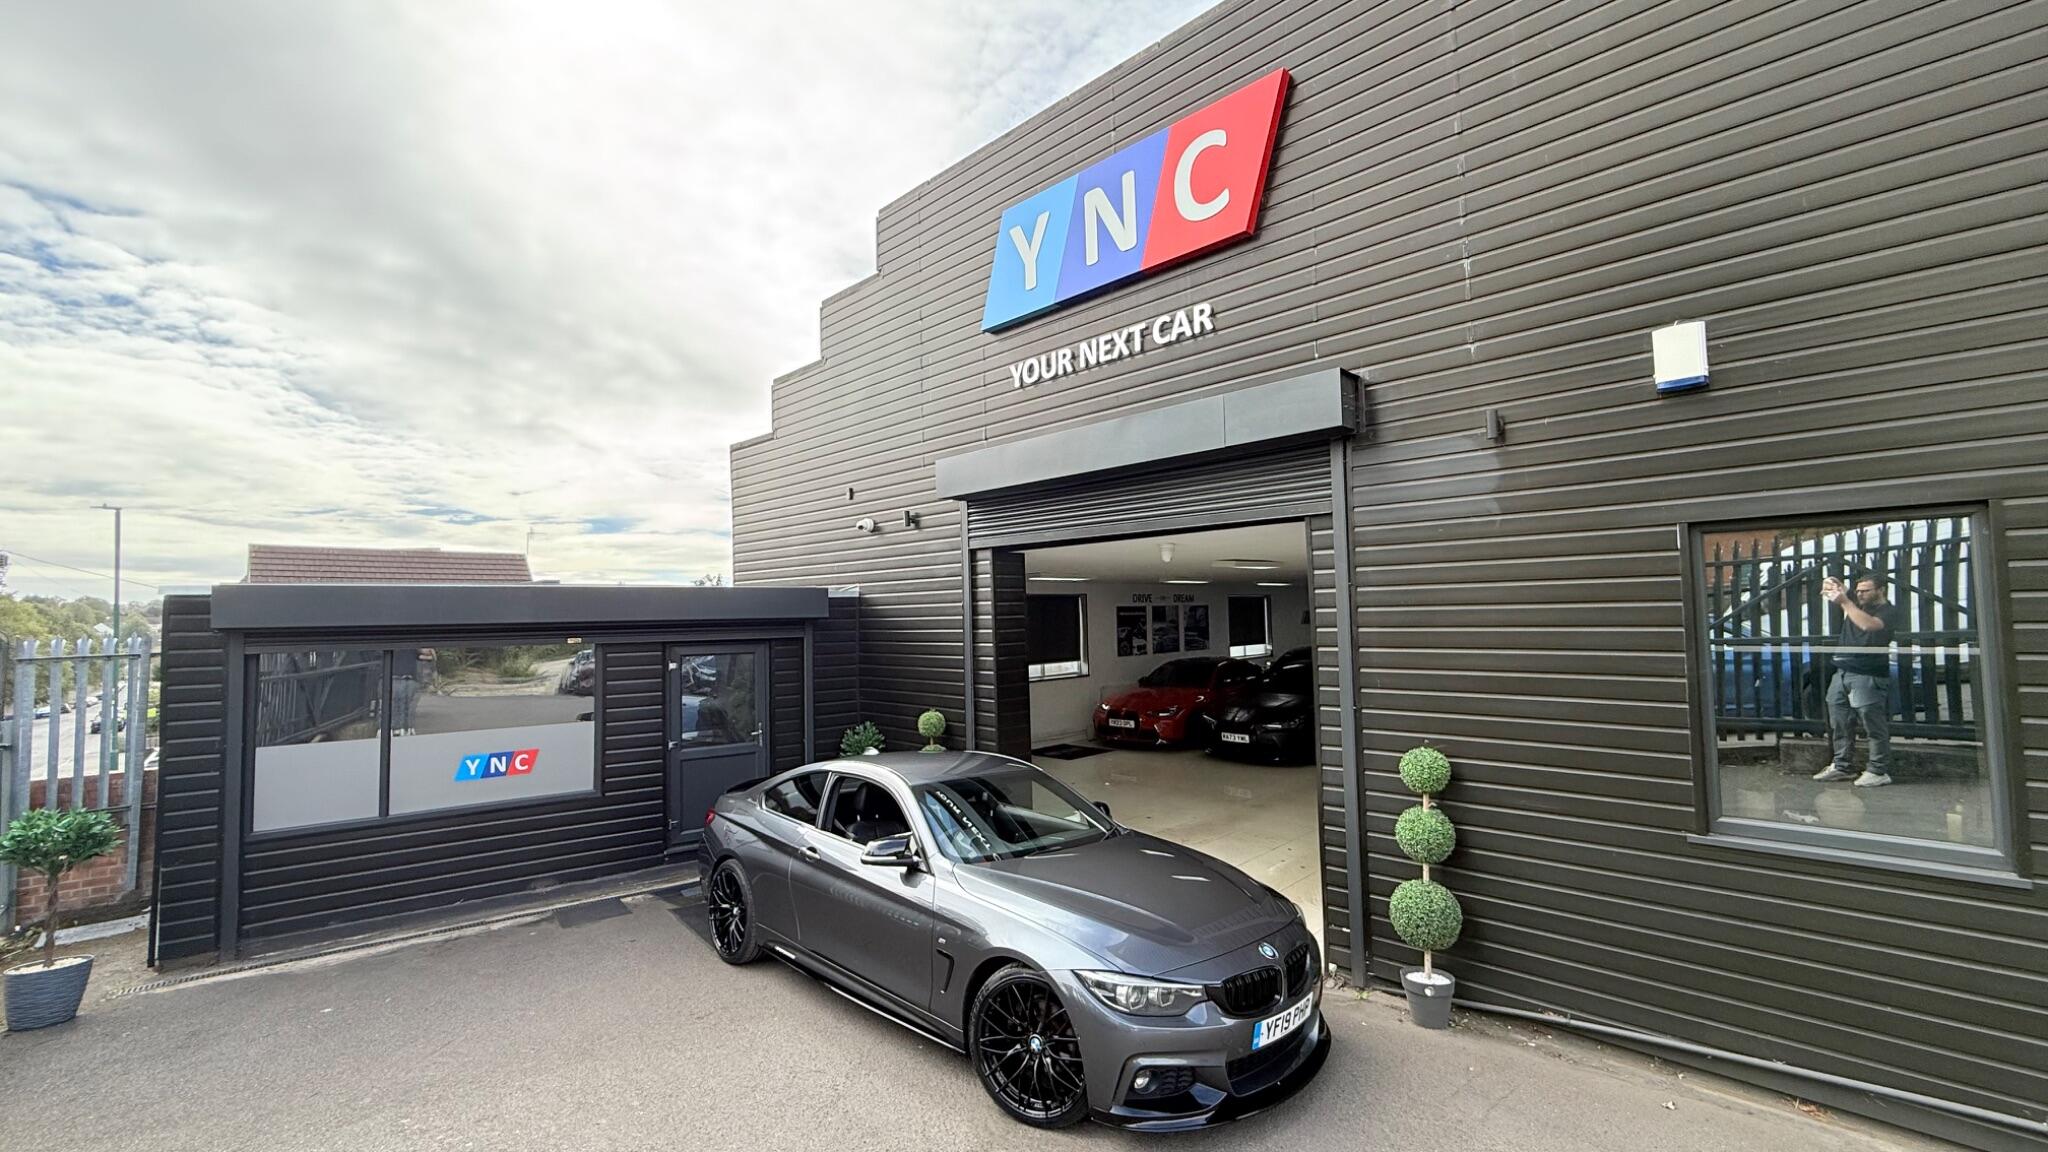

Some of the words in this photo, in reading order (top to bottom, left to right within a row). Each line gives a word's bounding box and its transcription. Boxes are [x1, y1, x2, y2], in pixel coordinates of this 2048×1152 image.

[1009, 129, 1230, 290] YNC
[1009, 348, 1073, 388] YOUR
[1079, 322, 1147, 368] NEXT
[1152, 303, 1214, 345] CAR
[1132, 593, 1153, 604] DRIVE
[1172, 593, 1195, 604] DREAM
[465, 754, 529, 776] YNC
[1266, 1011, 1292, 1040] YF19
